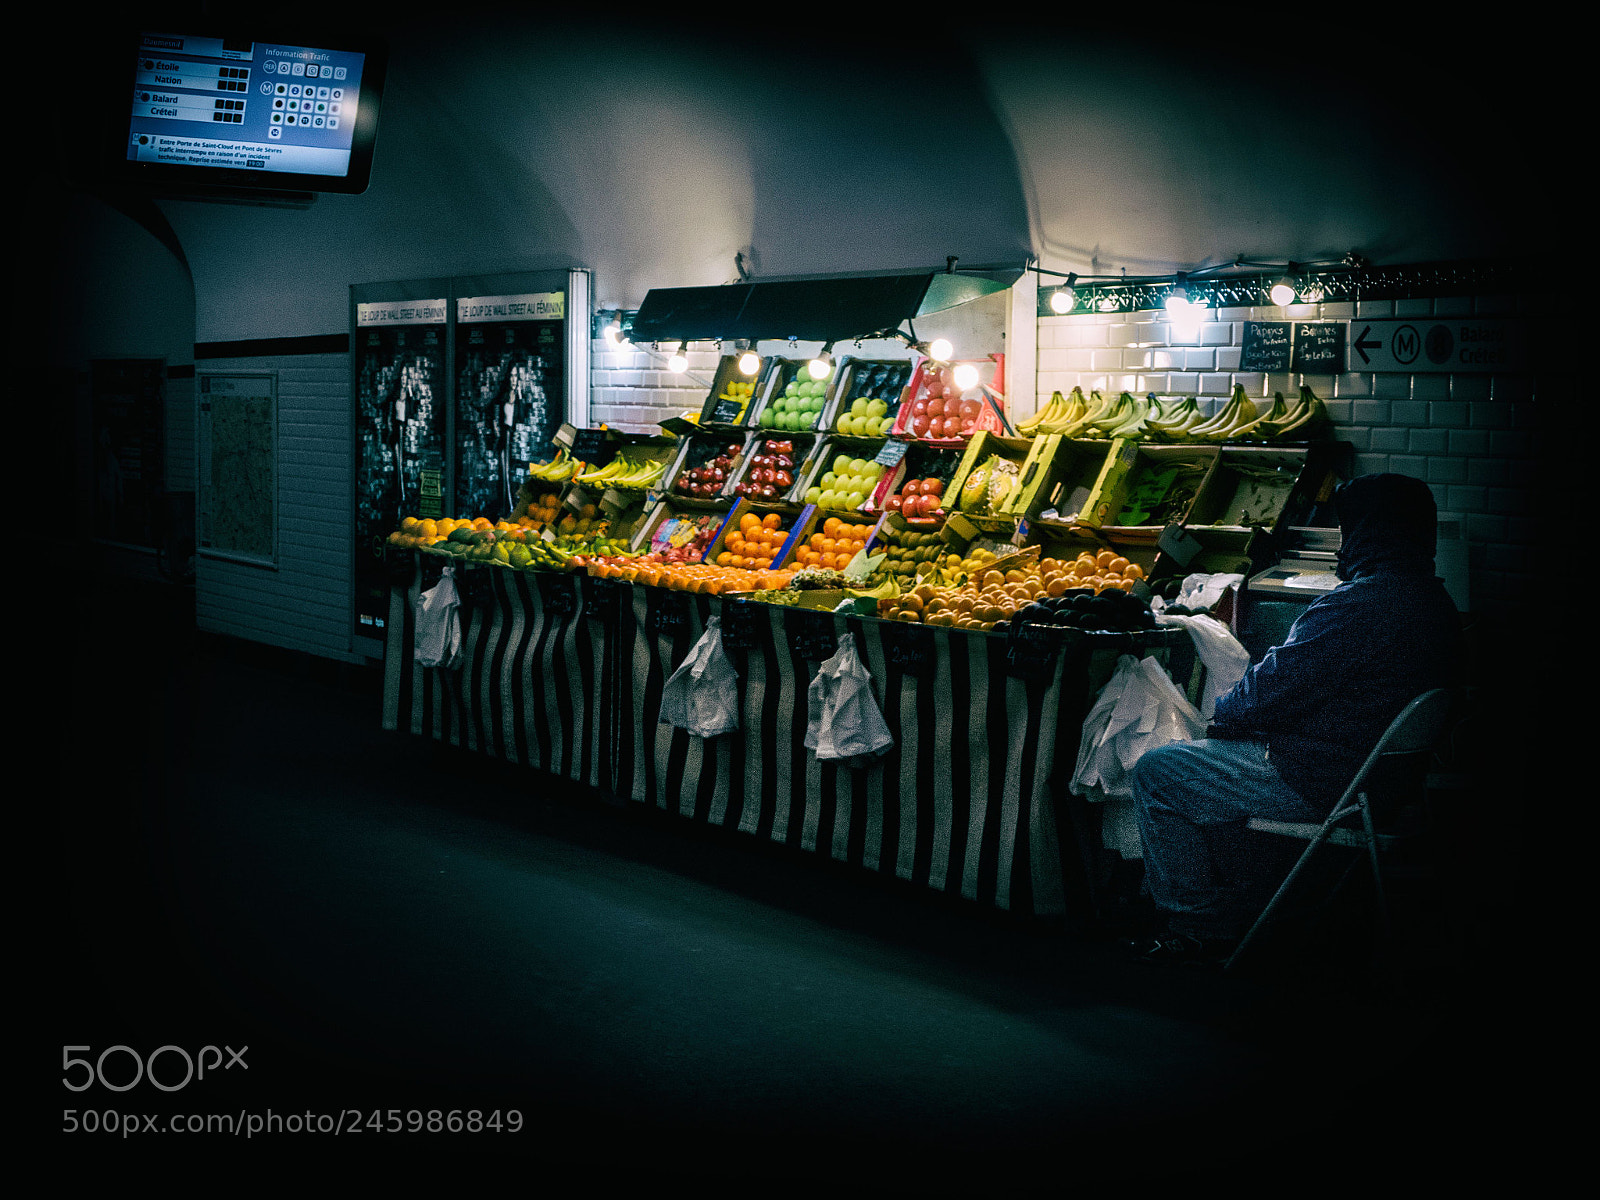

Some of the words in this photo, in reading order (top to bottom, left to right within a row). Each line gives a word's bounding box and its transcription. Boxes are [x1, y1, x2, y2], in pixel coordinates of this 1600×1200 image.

[265, 48, 308, 59] Information
[309, 52, 330, 61] Trafic
[156, 60, 180, 72] Étoile
[154, 75, 182, 85] Nation
[152, 94, 178, 104] Balard
[150, 107, 178, 117] Créteil
[160, 138, 175, 146] Entre
[176, 139, 192, 147] Porte
[202, 142, 234, 150] Saint-Cloud
[158, 153, 188, 161] technique.
[188, 154, 210, 163] Reprise
[210, 156, 233, 164] estimée
[175, 148, 206, 157] interrompu
[216, 150, 234, 158] raison
[248, 152, 270, 160] incident
[399, 308, 415, 319] STREET
[470, 305, 484, 317] LOUP
[484, 304, 492, 316] DE
[492, 304, 507, 316] WALL
[508, 303, 526, 315] STREET
[526, 302, 535, 314] AU
